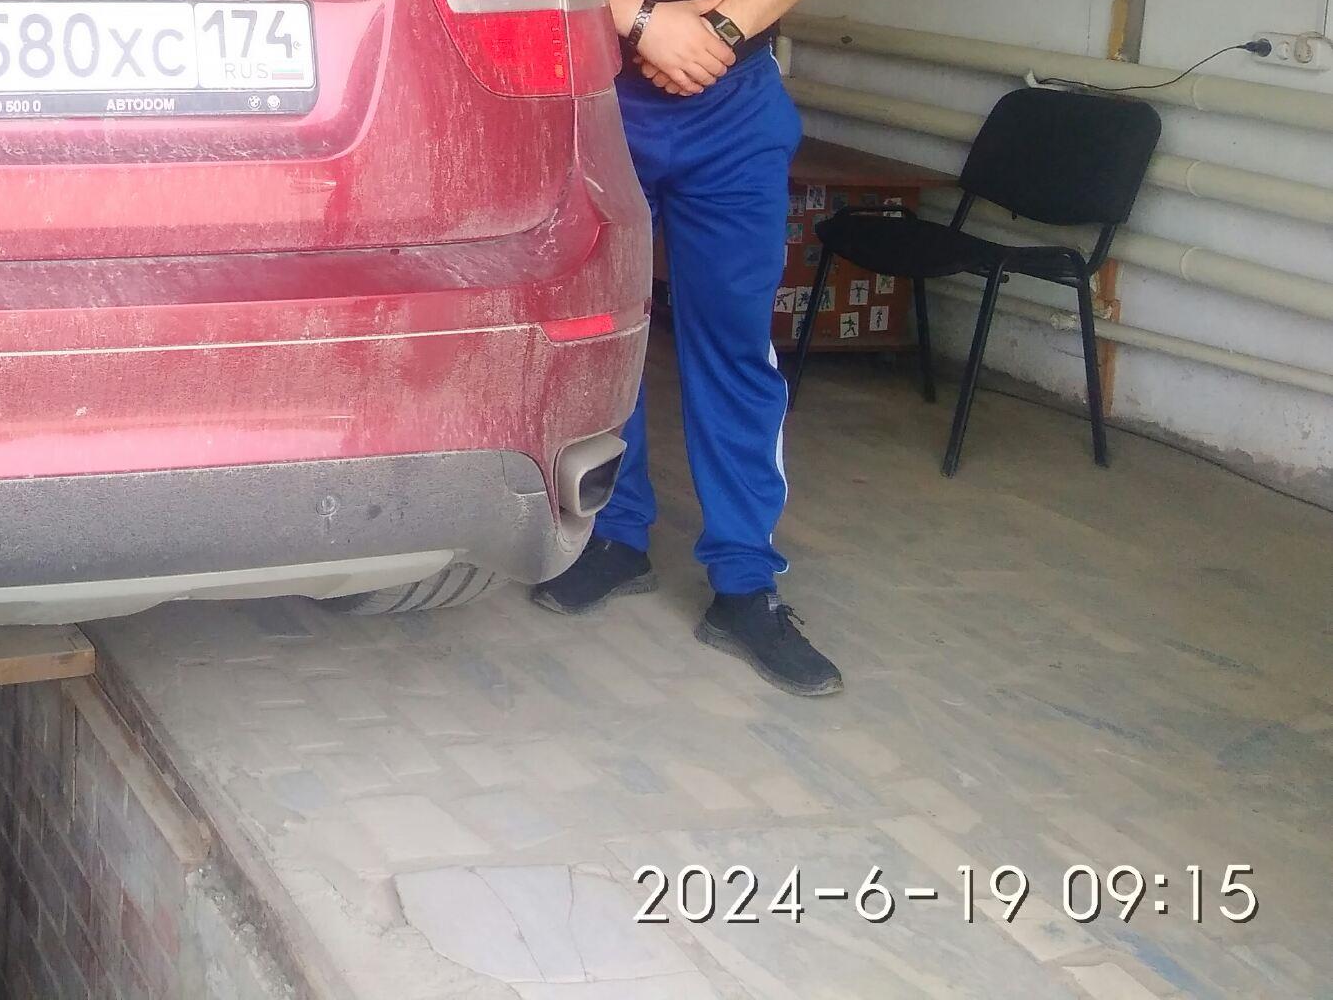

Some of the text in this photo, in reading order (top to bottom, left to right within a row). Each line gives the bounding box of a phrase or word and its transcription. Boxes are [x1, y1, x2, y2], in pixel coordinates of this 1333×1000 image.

[202, 9, 294, 59] 174
[224, 62, 269, 80] RUS
[5, 100, 30, 113] 500
